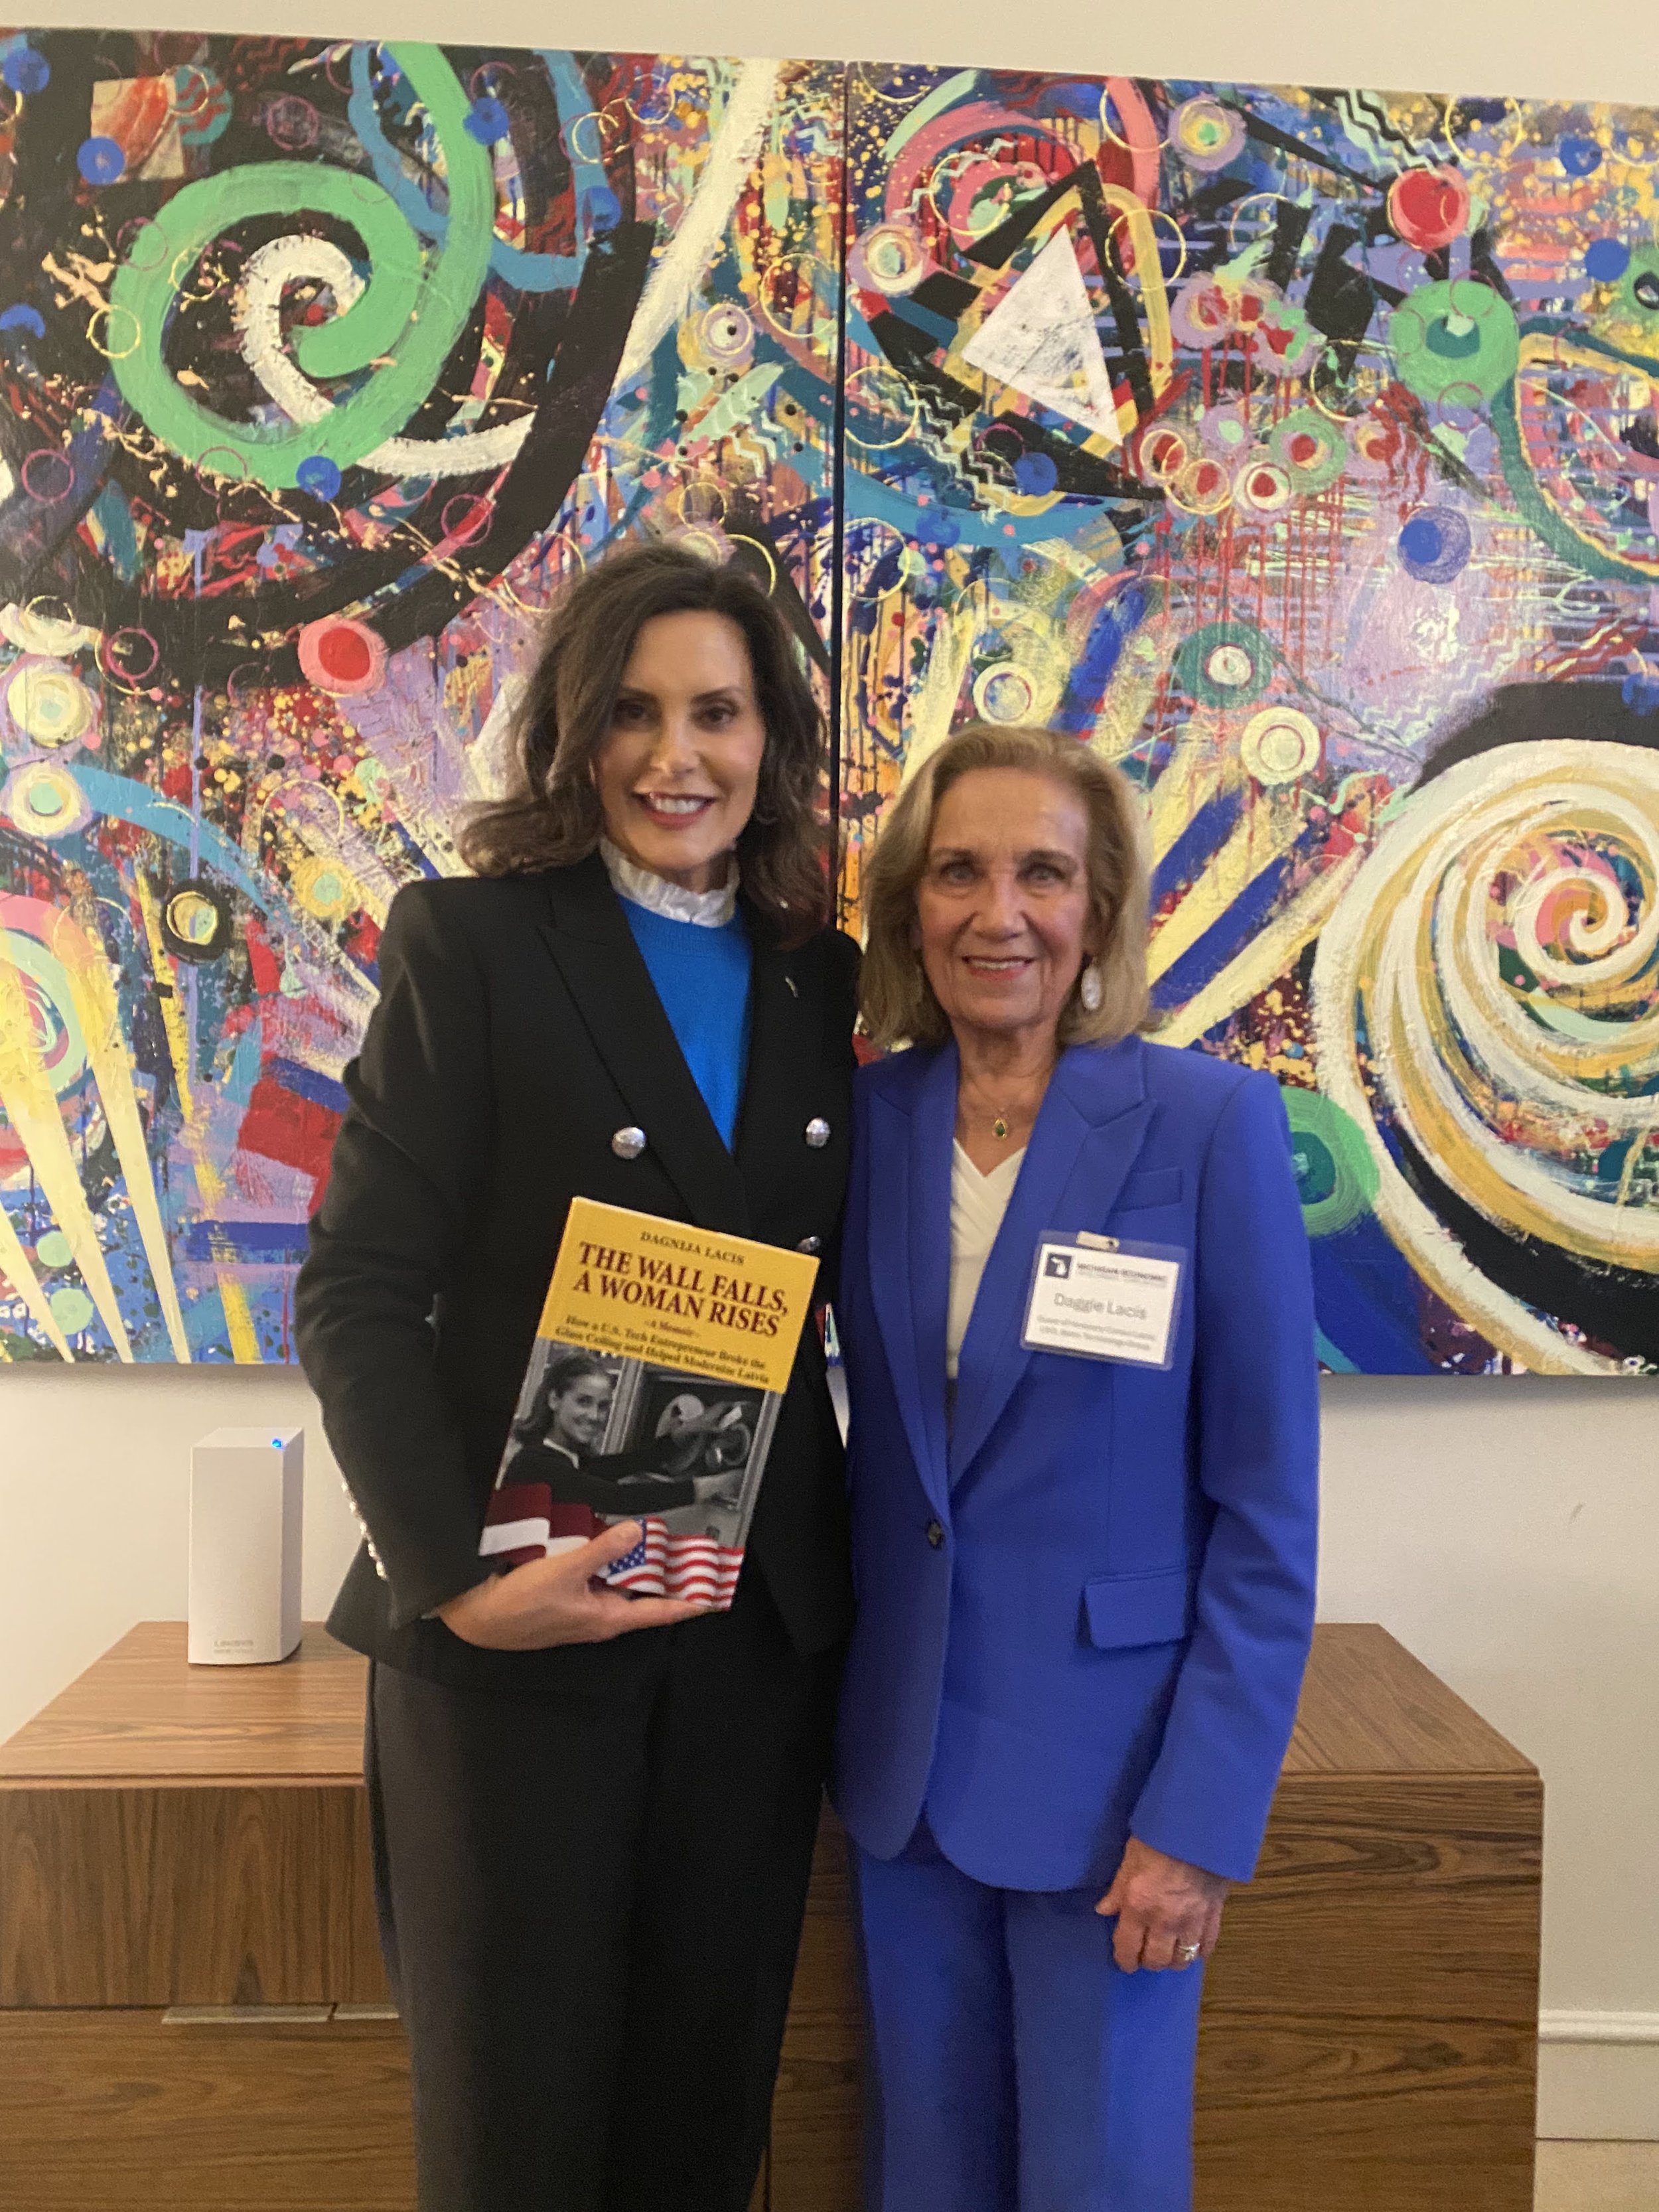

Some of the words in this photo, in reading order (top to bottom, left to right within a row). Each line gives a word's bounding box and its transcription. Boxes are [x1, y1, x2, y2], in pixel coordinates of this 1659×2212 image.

[705, 1246, 745, 1265] LACIS
[579, 1240, 632, 1276] THE
[638, 1254, 705, 1293] WALL
[709, 1273, 788, 1317] FALLS,
[573, 1269, 590, 1293] A
[600, 1273, 705, 1320] WOMAN
[708, 1300, 780, 1337] RISES
[1054, 1292, 1105, 1313] Daggie
[1106, 1298, 1147, 1320] Lacis
[623, 1343, 644, 1353] and
[737, 1367, 769, 1384] Latvia
[750, 1358, 766, 1369] the
